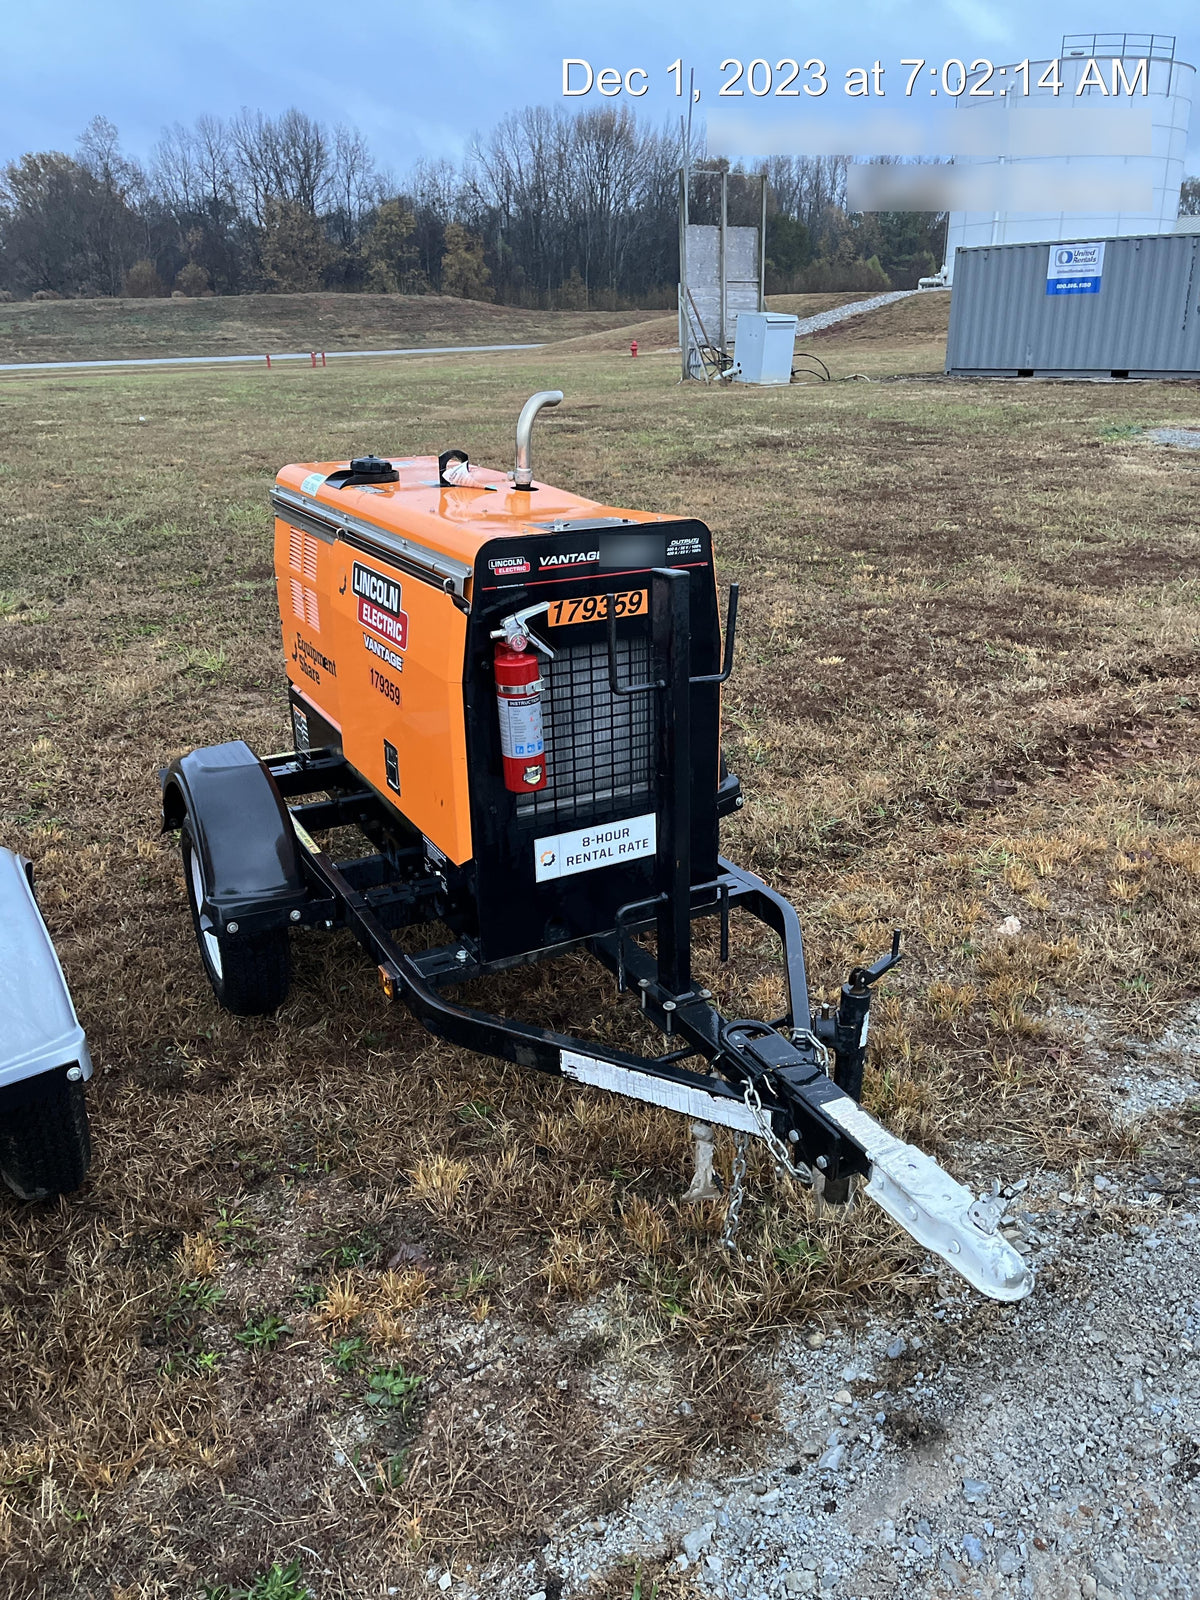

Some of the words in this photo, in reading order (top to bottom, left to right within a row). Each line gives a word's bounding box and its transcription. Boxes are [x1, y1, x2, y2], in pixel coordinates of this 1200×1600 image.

[490, 558, 523, 568] LINCOLN
[498, 566, 527, 574] ELECTRIC
[353, 567, 400, 613] LINCOLN
[553, 590, 643, 625] 179359
[362, 602, 403, 642] ELECTRIC
[296, 631, 337, 678] Equipment
[299, 654, 321, 685] Share
[362, 631, 404, 673] VANTAGE
[370, 667, 401, 706] 179359
[566, 847, 614, 867] RENTAL
[618, 838, 650, 855] RATE
[582, 827, 630, 848] 8-HOUR
